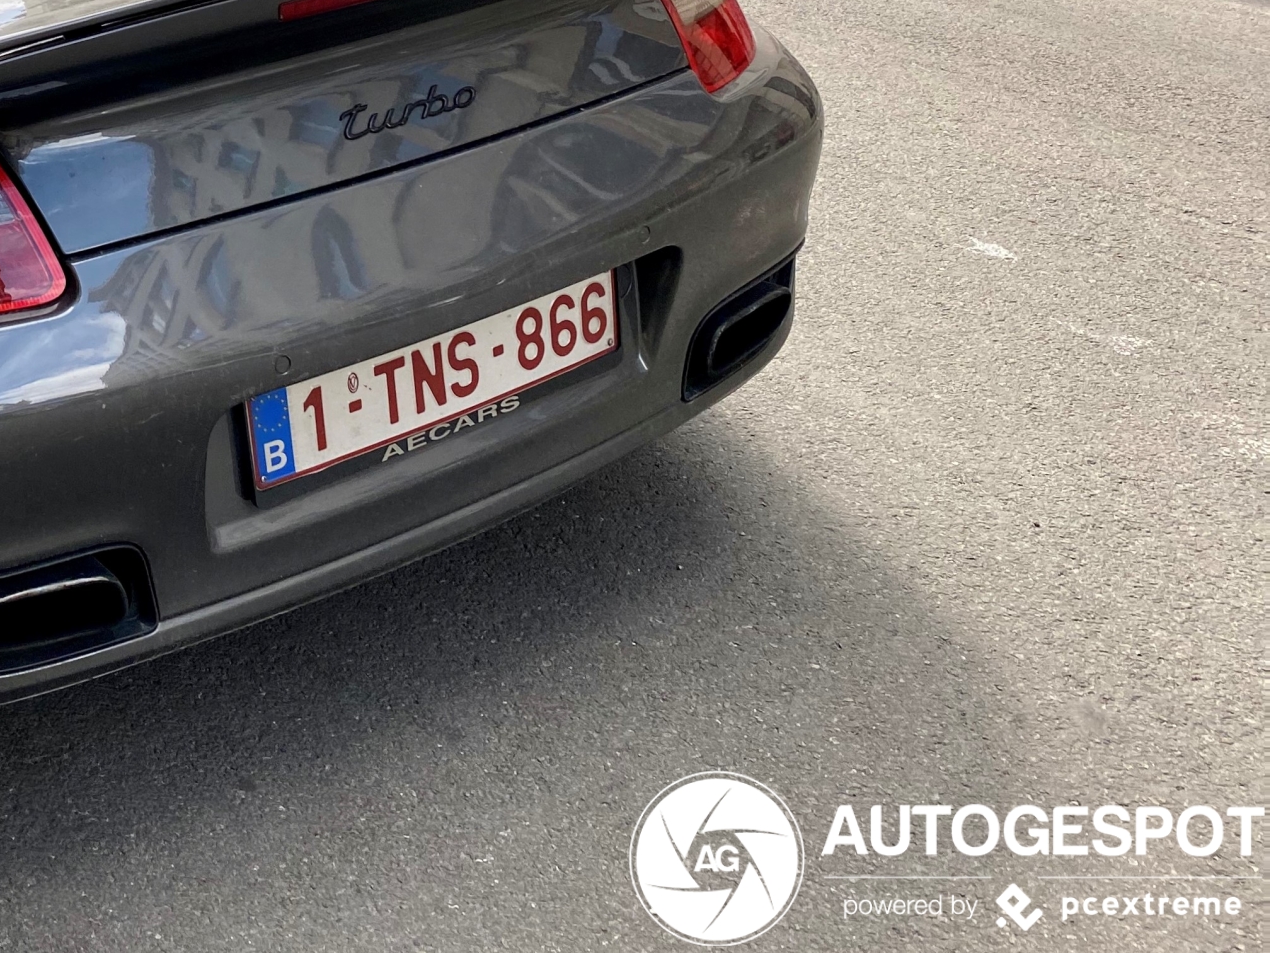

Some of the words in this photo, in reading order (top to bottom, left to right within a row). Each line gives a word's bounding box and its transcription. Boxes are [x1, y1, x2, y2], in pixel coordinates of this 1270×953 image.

[339, 84, 477, 141] turbo
[264, 439, 288, 473] B
[381, 394, 521, 462] AECARS
